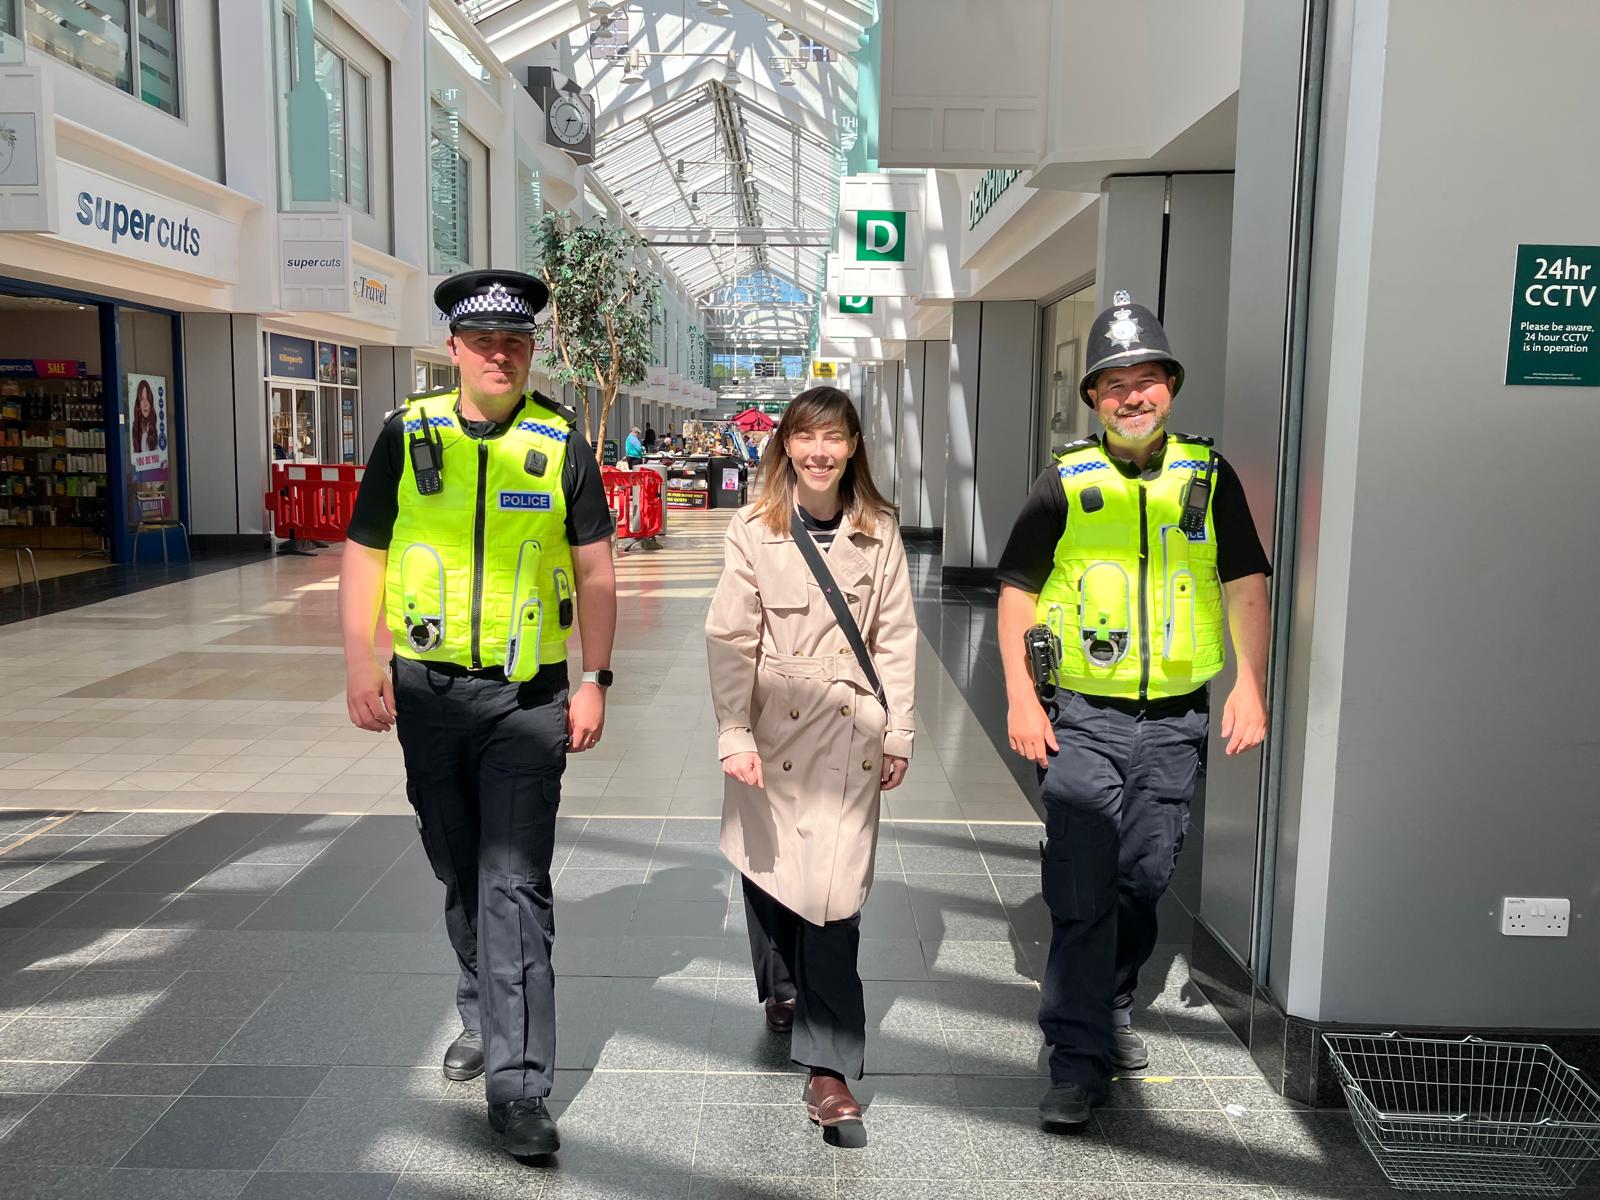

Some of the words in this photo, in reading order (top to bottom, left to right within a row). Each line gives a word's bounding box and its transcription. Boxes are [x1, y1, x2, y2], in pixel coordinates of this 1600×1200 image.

[76, 191, 200, 257] supercuts
[866, 219, 899, 254] D
[287, 258, 341, 269] supercuts
[1534, 257, 1592, 280] 24hr
[360, 276, 387, 305] Travel
[1525, 284, 1597, 307] CCTV
[1520, 322, 1549, 331] Please
[1552, 322, 1564, 331] be
[1566, 324, 1595, 332] aware,
[1525, 333, 1536, 341] 24
[1538, 333, 1560, 342] hour
[1562, 333, 1588, 342] CCTV
[1523, 343, 1530, 351] is
[1533, 343, 1541, 352] in
[1543, 344, 1588, 354] operation
[47, 363, 66, 374] SALE
[502, 495, 548, 507] POLICE
